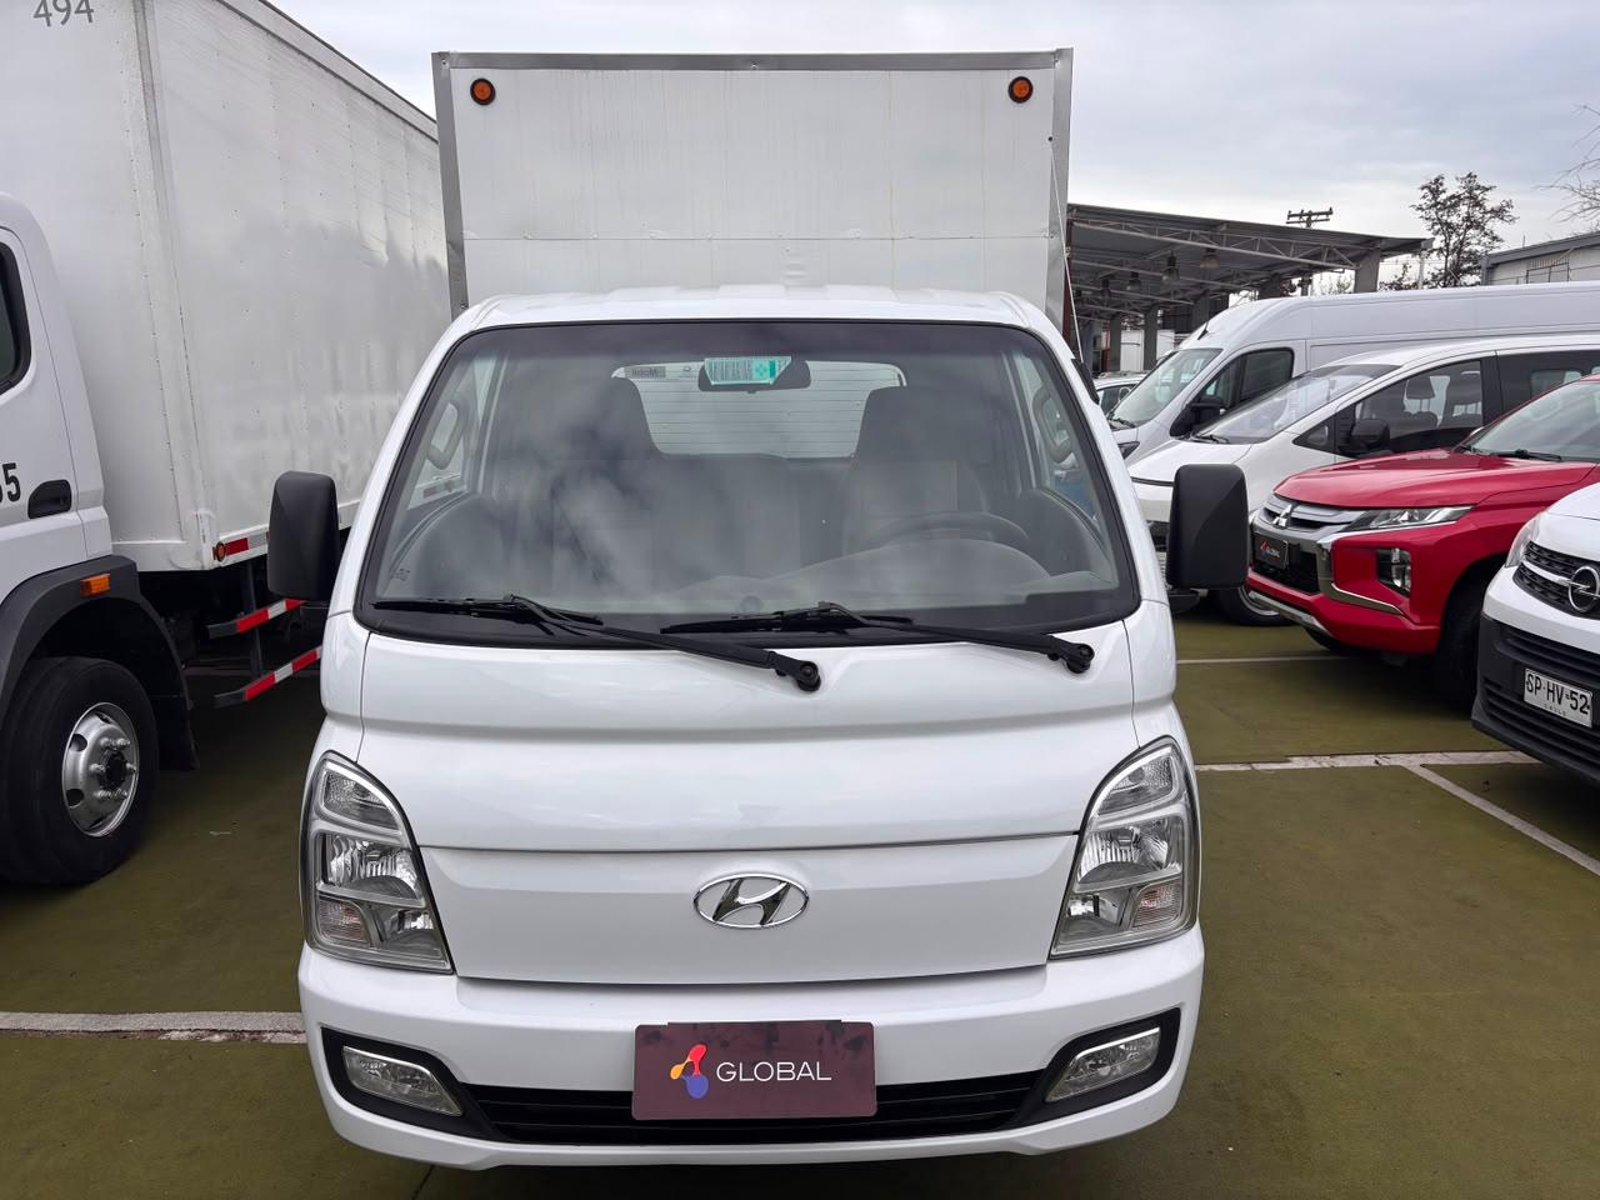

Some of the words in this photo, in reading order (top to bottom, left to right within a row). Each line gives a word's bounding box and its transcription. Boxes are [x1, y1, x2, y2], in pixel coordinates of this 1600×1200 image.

[33, 0, 95, 27] 494
[0, 462, 21, 502] 5
[716, 1061, 832, 1082] GLOBAL
